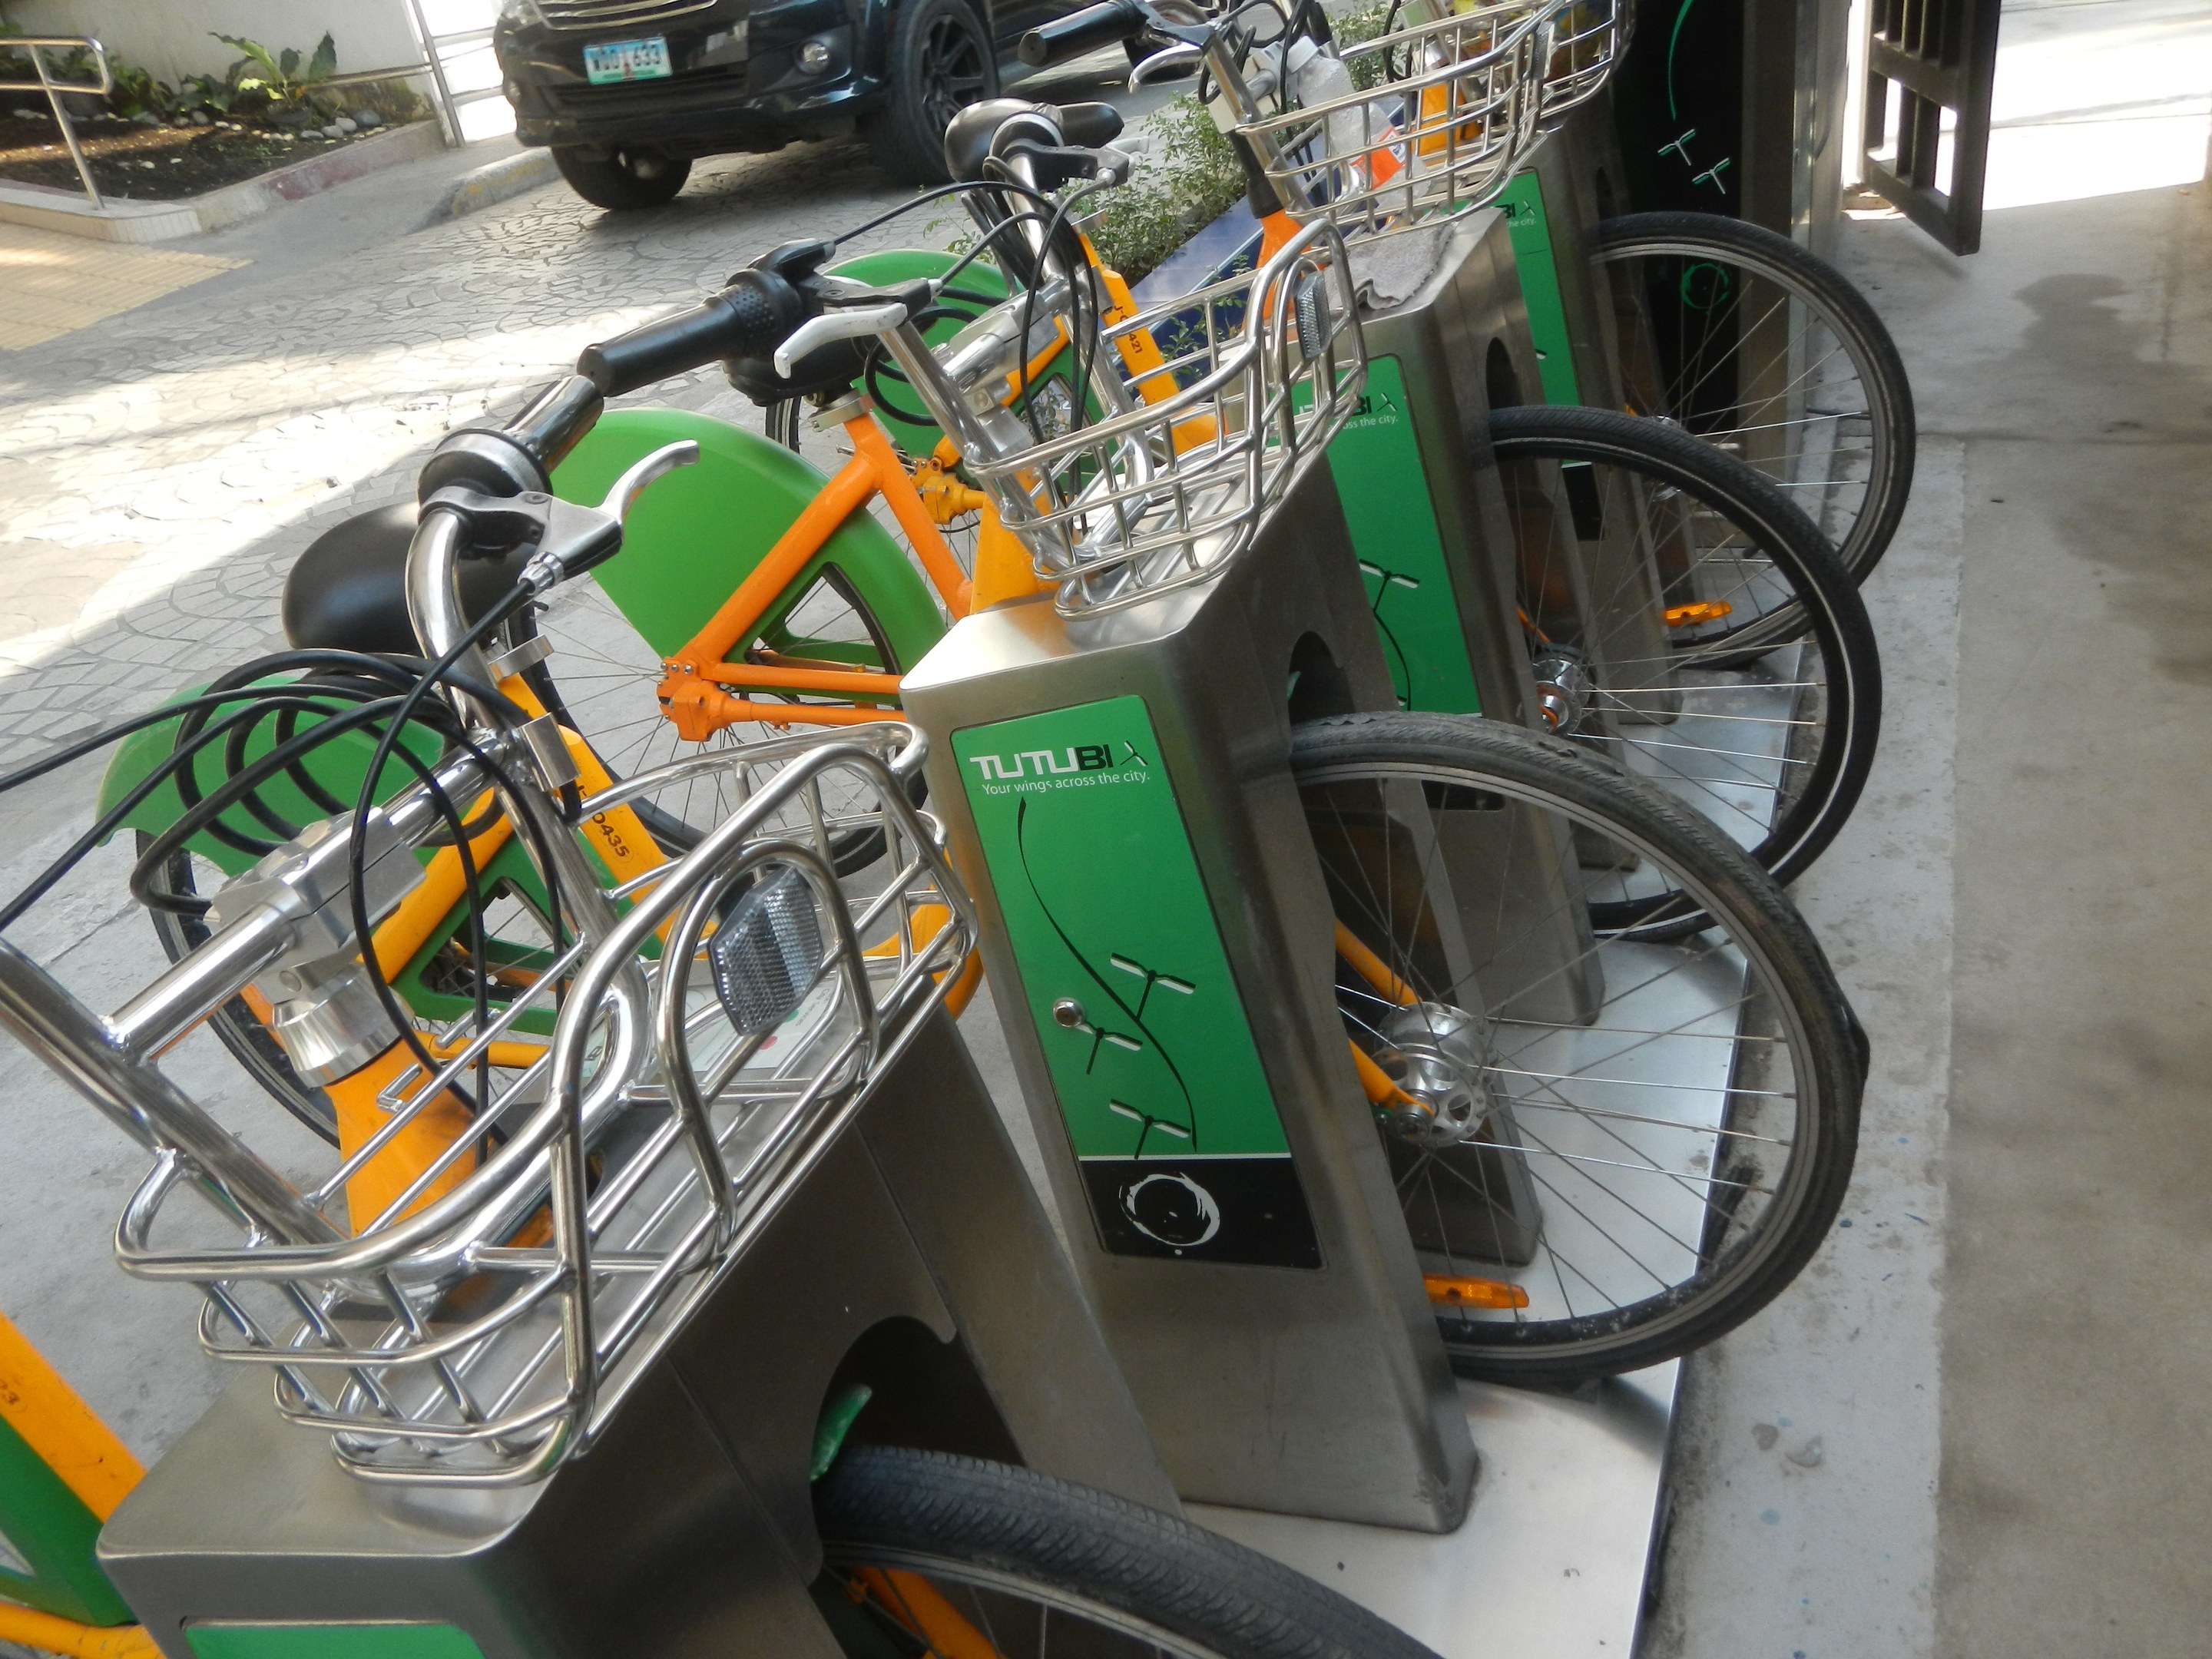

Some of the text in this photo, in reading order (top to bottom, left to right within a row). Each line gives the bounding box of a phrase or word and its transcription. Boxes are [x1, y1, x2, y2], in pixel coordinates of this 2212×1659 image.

[1359, 417, 1376, 427] the
[969, 743, 1114, 780] TUTUBI
[982, 769, 1151, 795] Your wings across the city.
